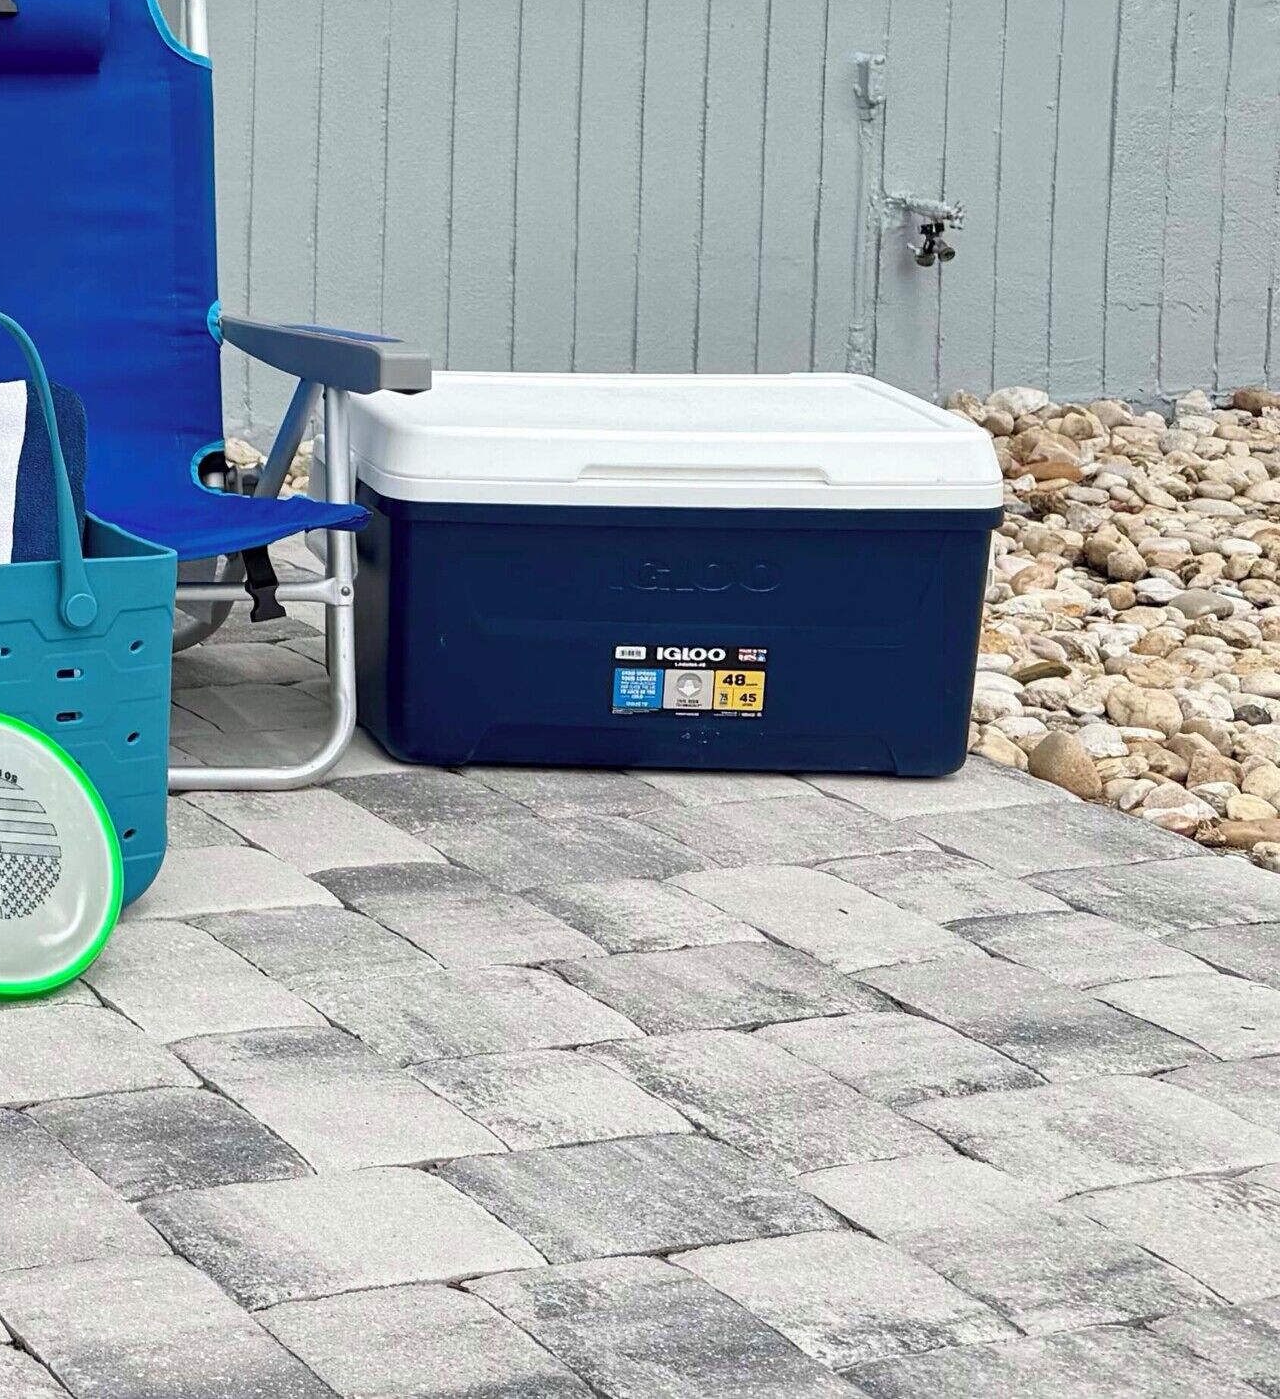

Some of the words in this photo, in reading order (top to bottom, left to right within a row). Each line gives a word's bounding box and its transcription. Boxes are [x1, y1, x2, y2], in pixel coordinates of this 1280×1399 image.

[609, 562, 782, 592] IGLOO
[657, 647, 727, 662] IGLOO
[723, 674, 746, 686] 48
[740, 693, 757, 703] 45
